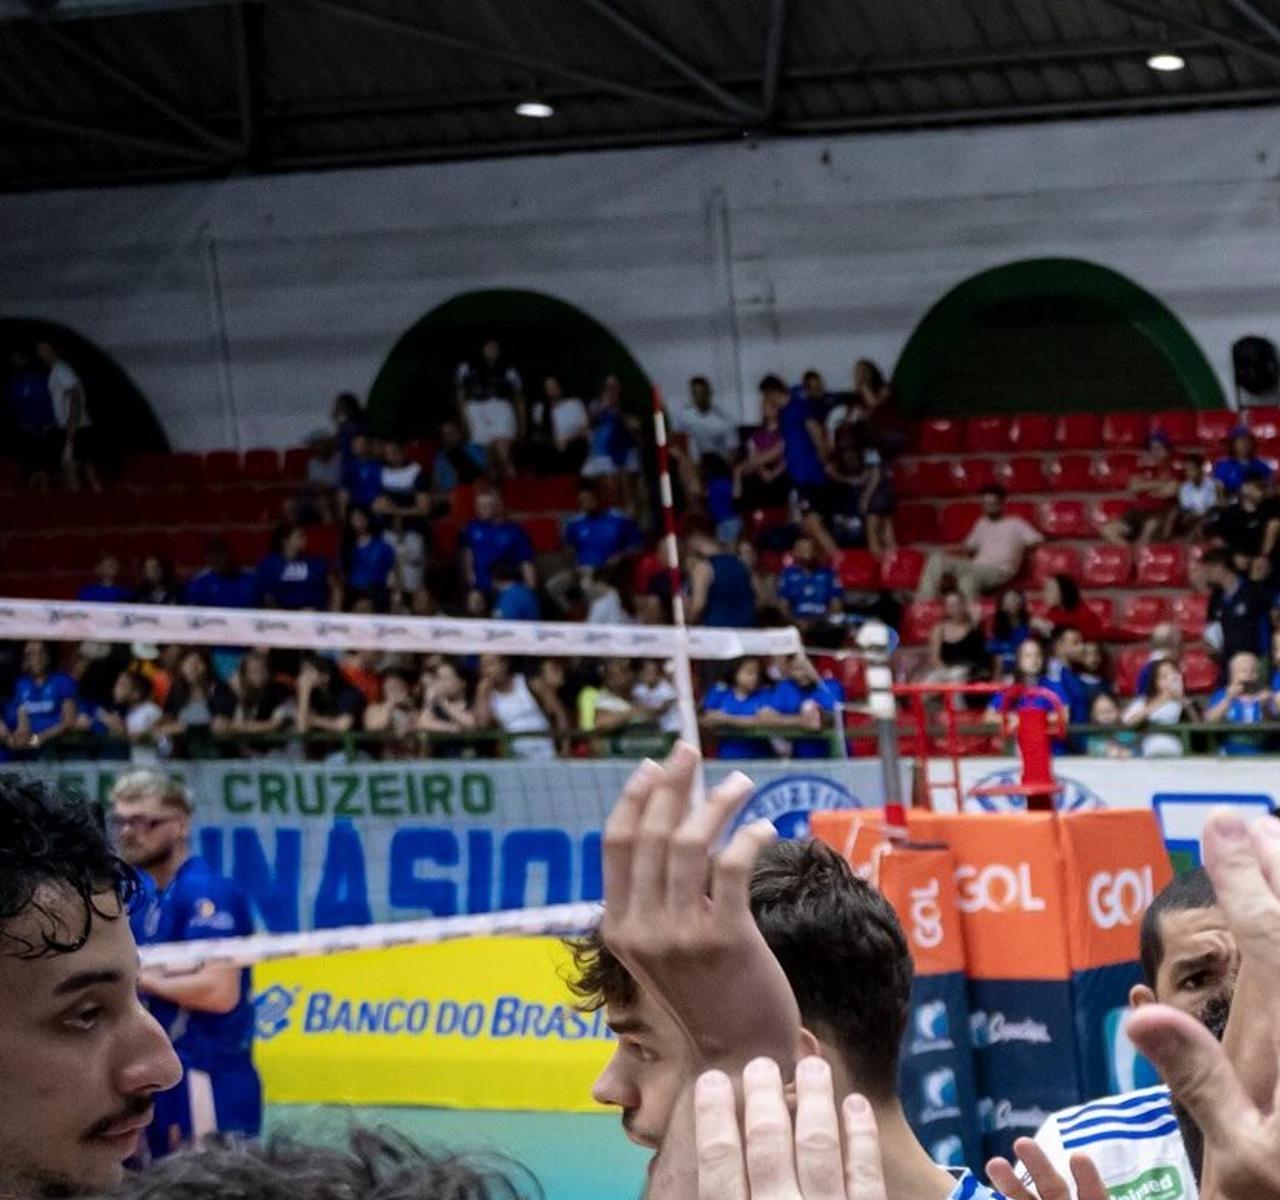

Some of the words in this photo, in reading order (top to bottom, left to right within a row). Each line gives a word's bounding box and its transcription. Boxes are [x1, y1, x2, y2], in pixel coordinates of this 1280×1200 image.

[222, 772, 496, 816] CRUZEIRO
[303, 993, 429, 1036] BANCO
[435, 995, 485, 1037] DO
[490, 995, 614, 1039] BRASI
